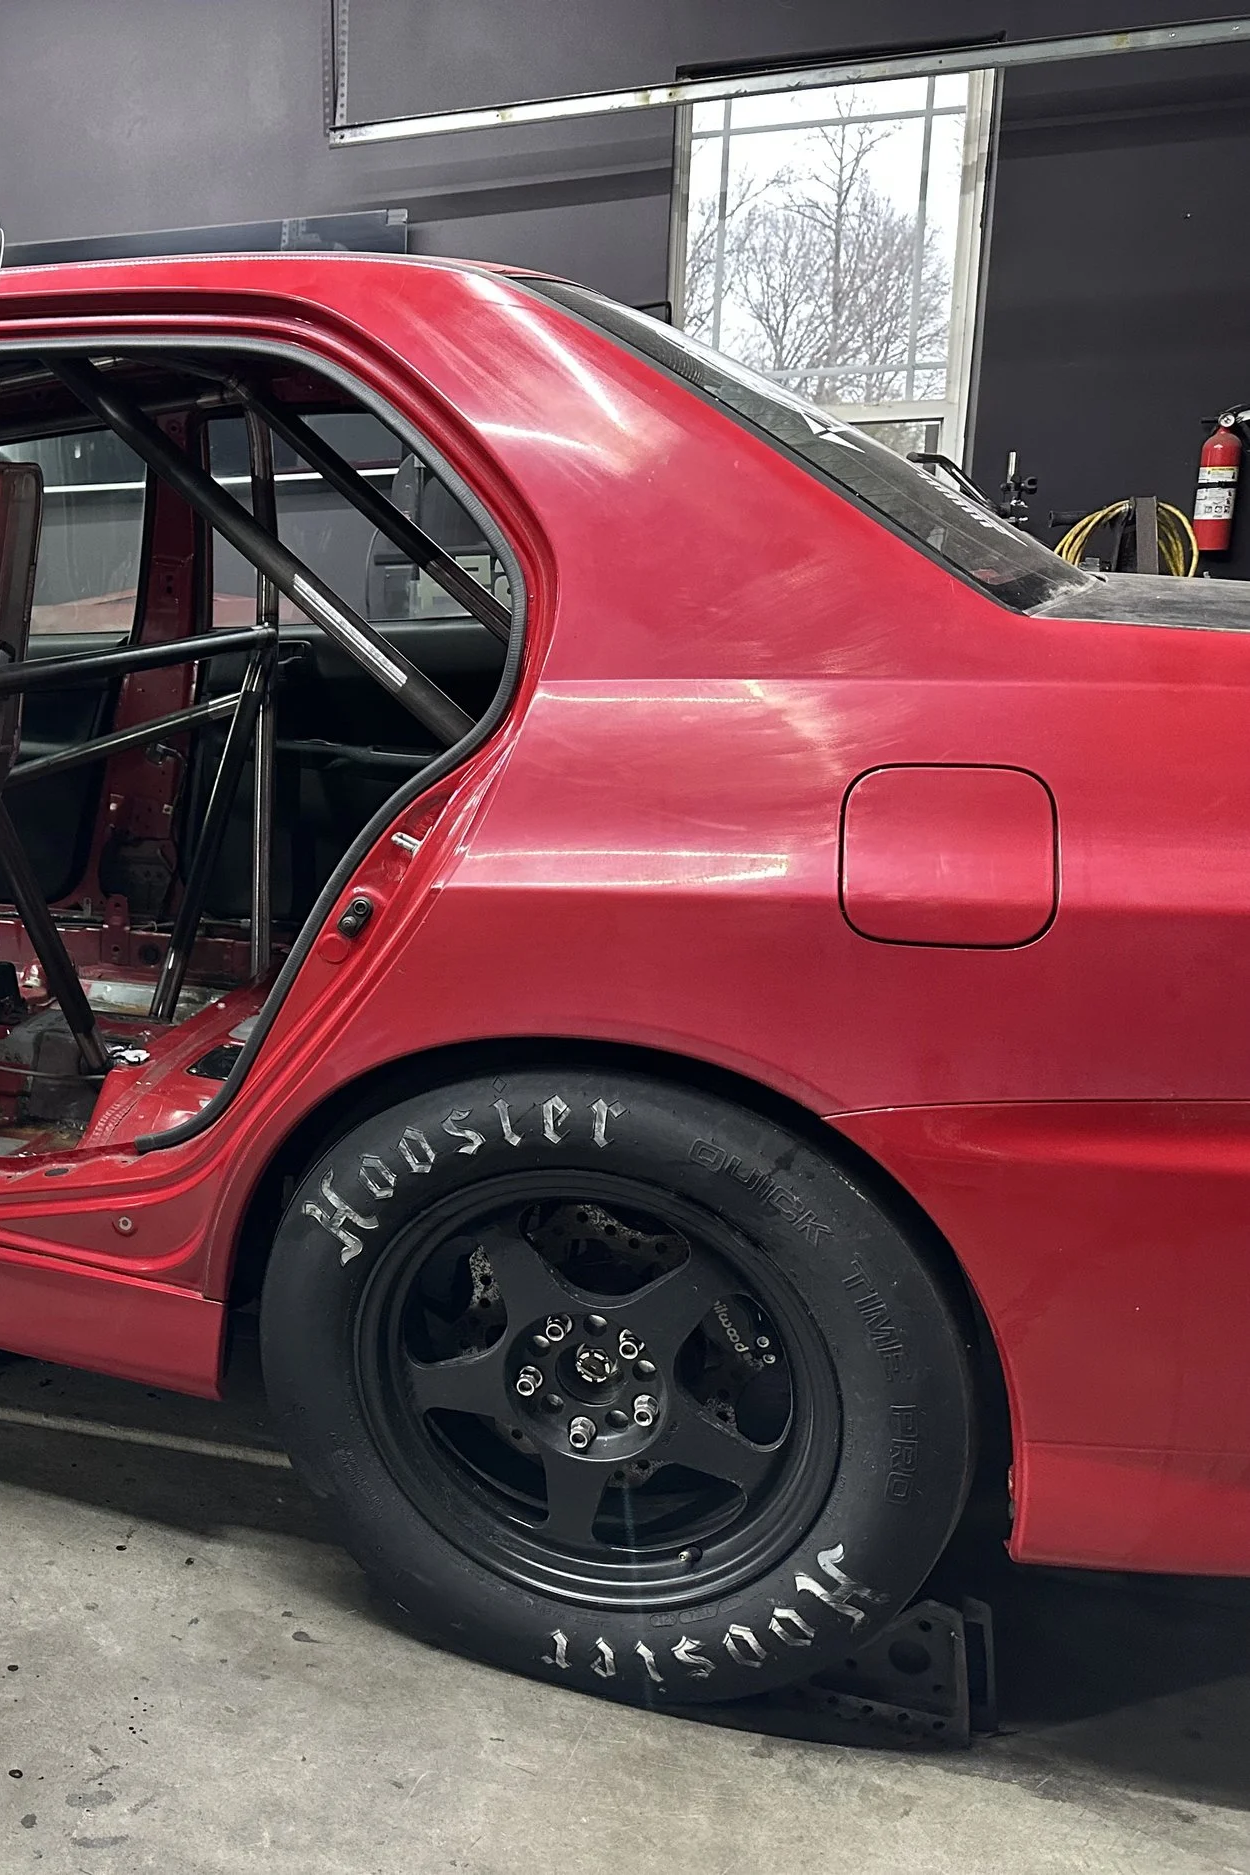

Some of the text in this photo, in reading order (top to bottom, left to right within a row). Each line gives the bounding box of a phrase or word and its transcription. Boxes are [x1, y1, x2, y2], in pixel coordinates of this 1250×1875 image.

[301, 1077, 629, 1268] Hoosier
[688, 1137, 836, 1248] QUICK
[841, 1251, 910, 1382] TIME
[884, 1402, 919, 1504] PRO
[540, 1543, 889, 1694] Hoosier
